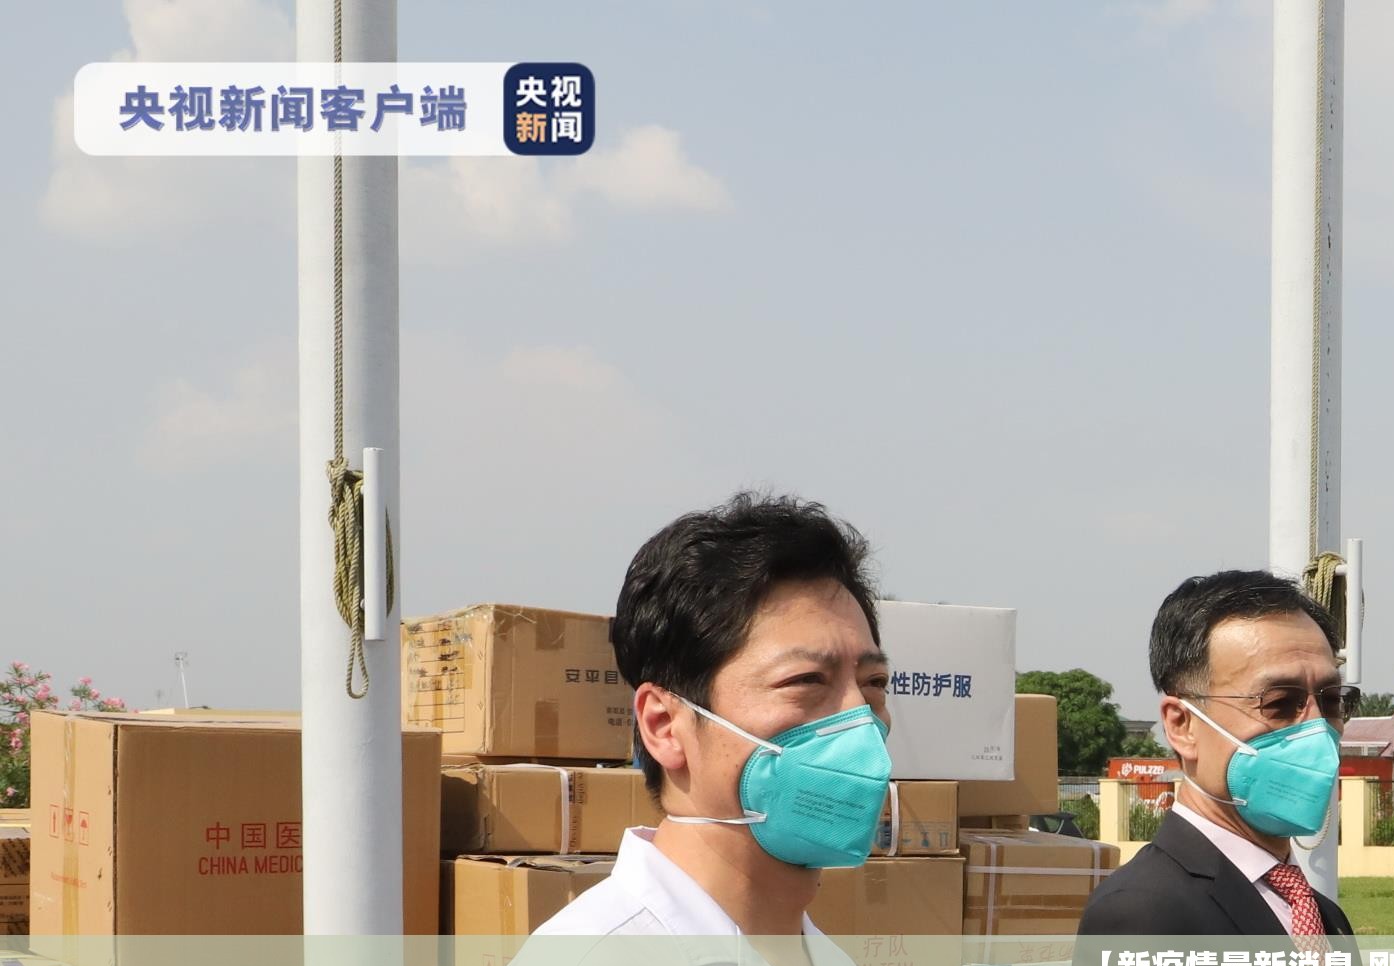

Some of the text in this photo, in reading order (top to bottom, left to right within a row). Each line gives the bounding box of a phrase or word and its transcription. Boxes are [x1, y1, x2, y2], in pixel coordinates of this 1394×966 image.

[886, 671, 972, 698] 性防护服
[205, 821, 303, 849] 中国医
[198, 856, 249, 875] CHINA
[863, 934, 908, 958] 疗队
